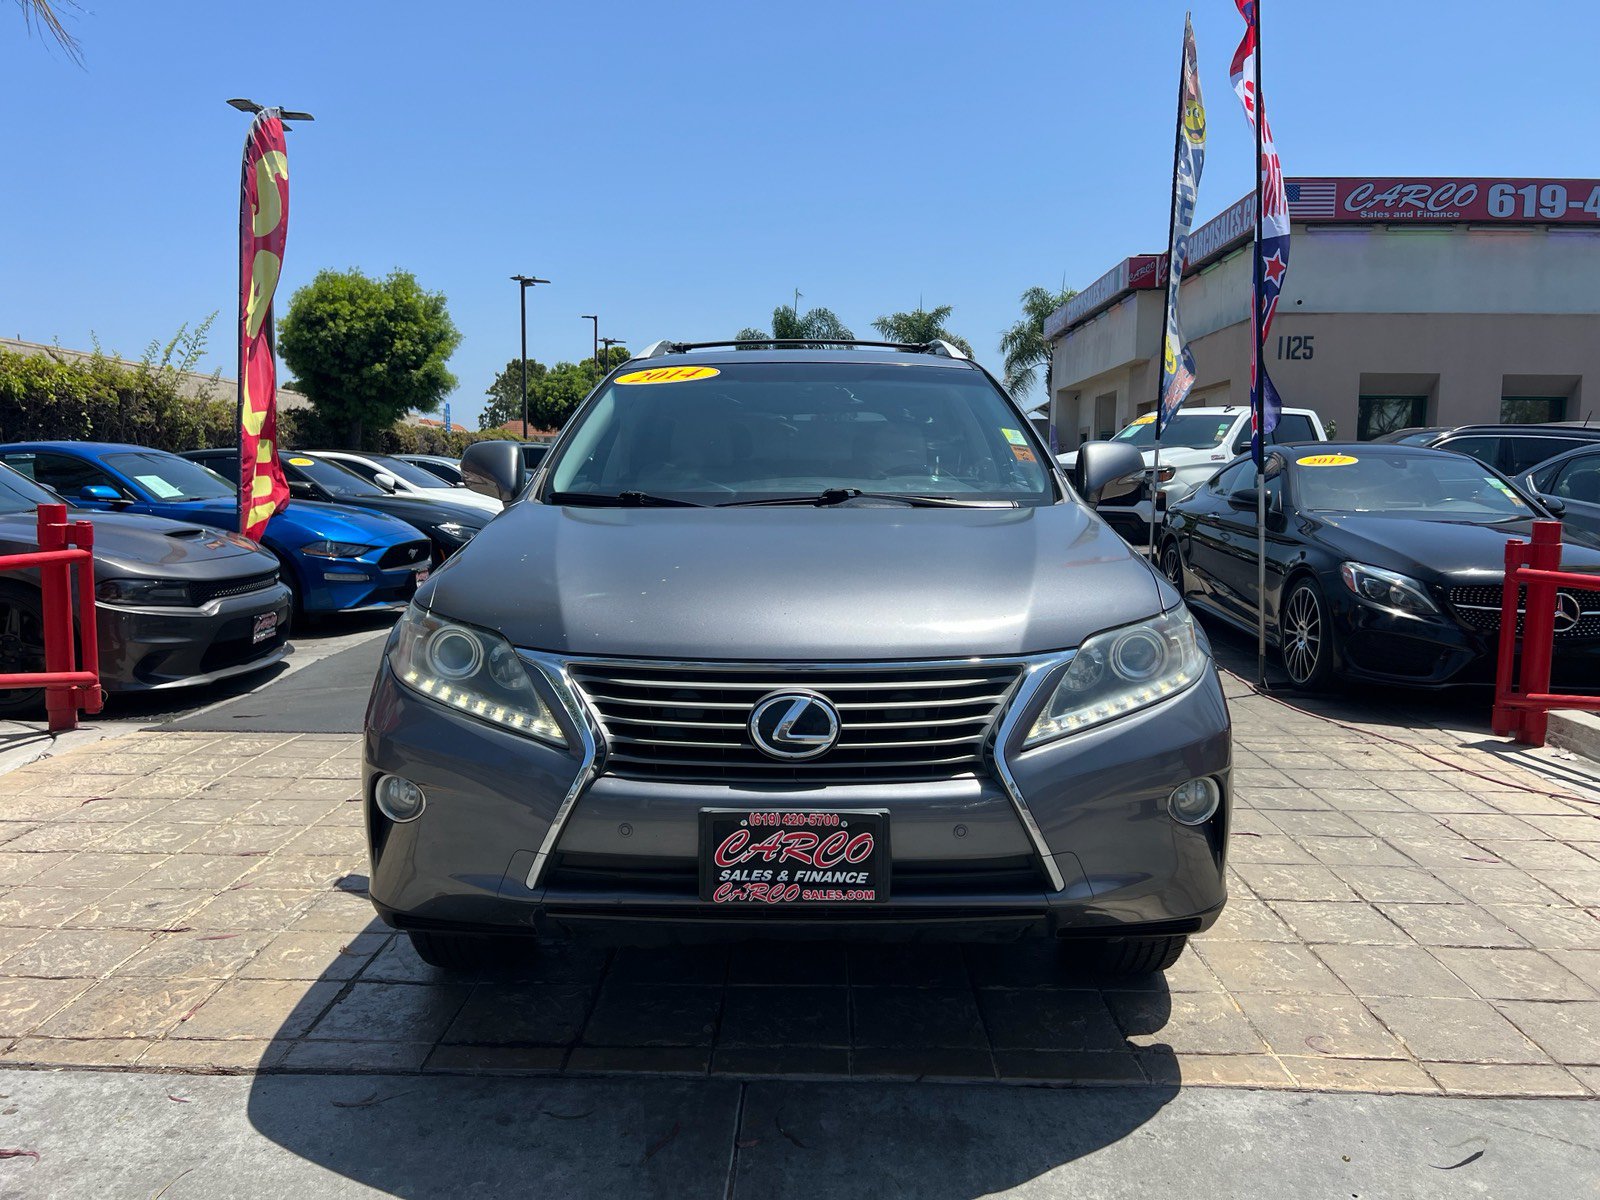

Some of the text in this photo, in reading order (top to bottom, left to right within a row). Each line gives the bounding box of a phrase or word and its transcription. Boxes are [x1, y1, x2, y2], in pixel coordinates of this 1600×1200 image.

[1343, 182, 1479, 212] CARCO
[1487, 183, 1600, 218] 619-4
[1360, 210, 1460, 218] Sales and Finance
[1277, 335, 1314, 360] 1125
[629, 368, 704, 383] 2014
[1307, 456, 1347, 465] 2017
[749, 812, 781, 827] (619)
[714, 829, 875, 869] CARCO
[718, 869, 870, 884] SALES & FINANCE
[713, 881, 876, 904] CARCO SALES.COM
